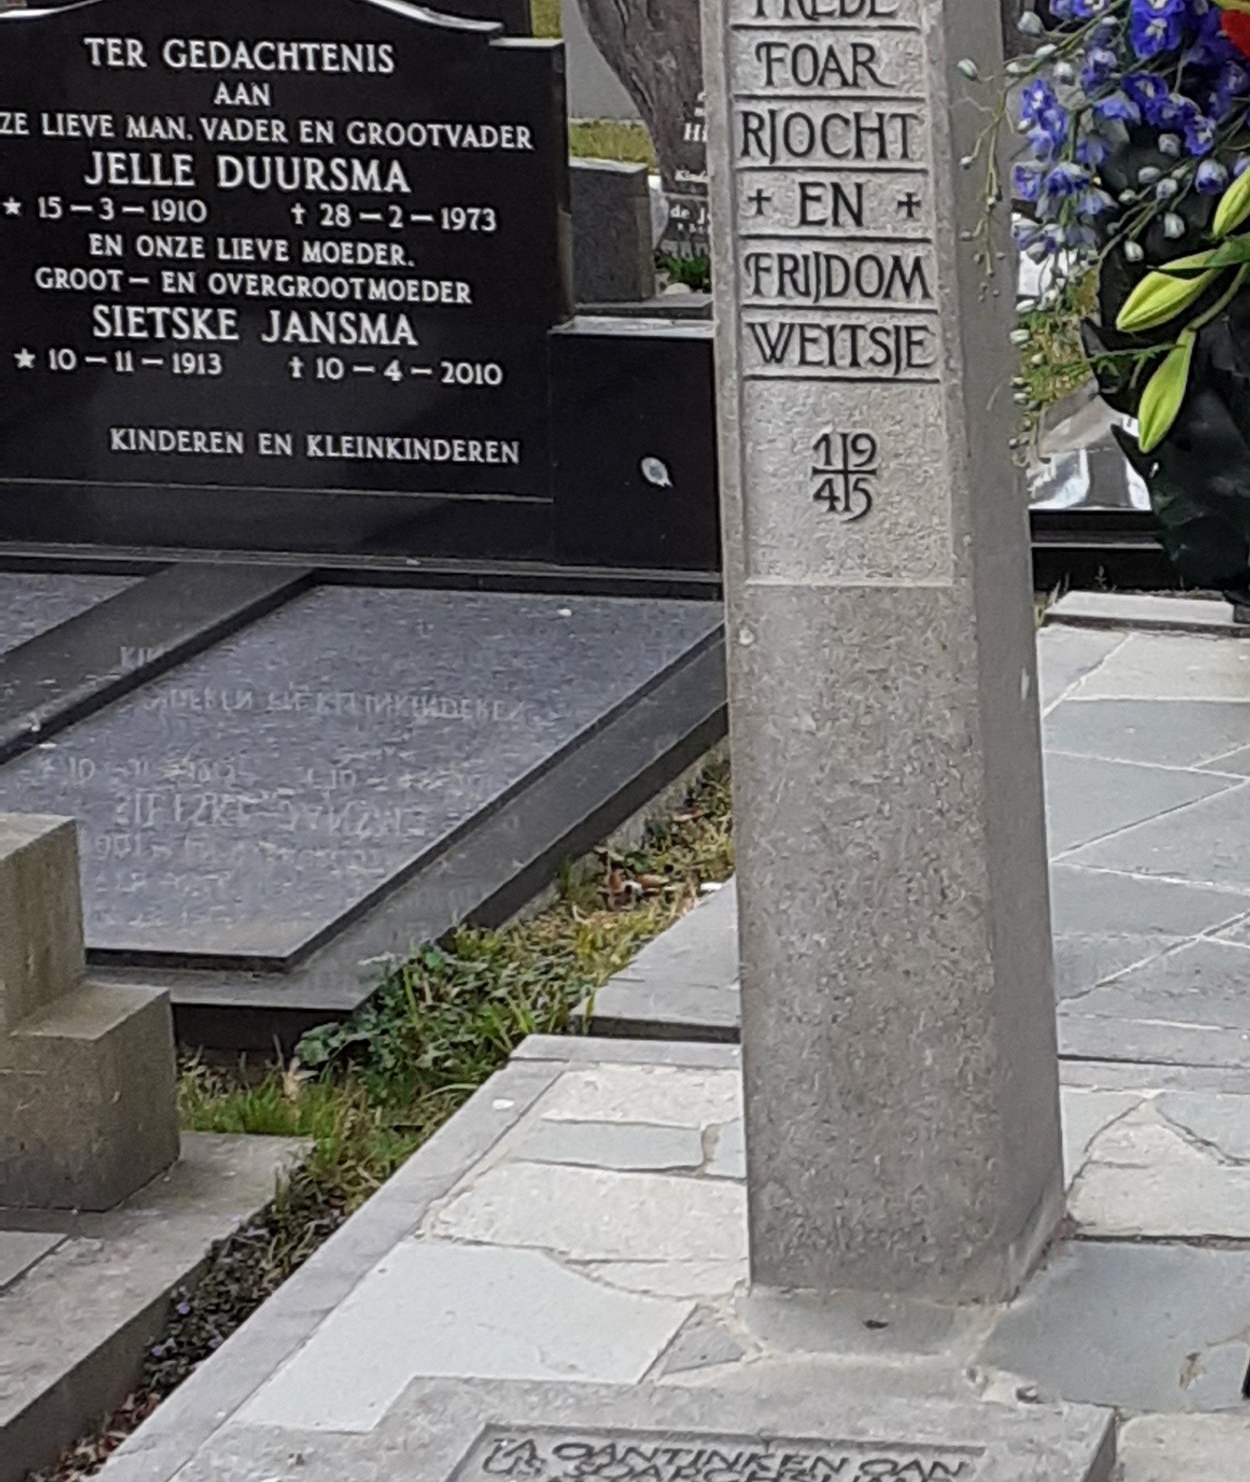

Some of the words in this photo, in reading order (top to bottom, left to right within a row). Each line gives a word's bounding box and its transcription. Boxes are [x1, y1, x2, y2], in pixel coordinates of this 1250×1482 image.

[83, 37, 147, 68] TER
[163, 39, 396, 74] GEDACHTENIS
[755, 41, 897, 89] FOAR
[213, 82, 271, 107] AAN
[42, 113, 114, 139] LIEVE
[202, 118, 289, 144] VADER
[300, 120, 334, 145] EN
[346, 122, 534, 151] GROOTVADER
[739, 110, 921, 164] RJOCHT
[84, 151, 196, 188] JELLE
[217, 155, 412, 194] DUURSMA
[798, 181, 865, 227] EN
[89, 233, 123, 258] EN
[136, 235, 205, 261] ONZE
[217, 237, 290, 263] LIEVE
[161, 270, 195, 294] EN
[208, 271, 472, 305] OVERGROOTMOEDER
[744, 250, 932, 303] FRIJDOM
[92, 304, 240, 342] SIETSKE
[261, 308, 418, 347] JANSMA
[745, 321, 937, 375] WEITSJE
[110, 428, 244, 456] KINDEREN
[259, 433, 292, 457] EN
[307, 433, 520, 465] KLEINKINDEREN
[547, 1442, 848, 1474] OANTINKEN
[857, 1458, 967, 1480] OAN
